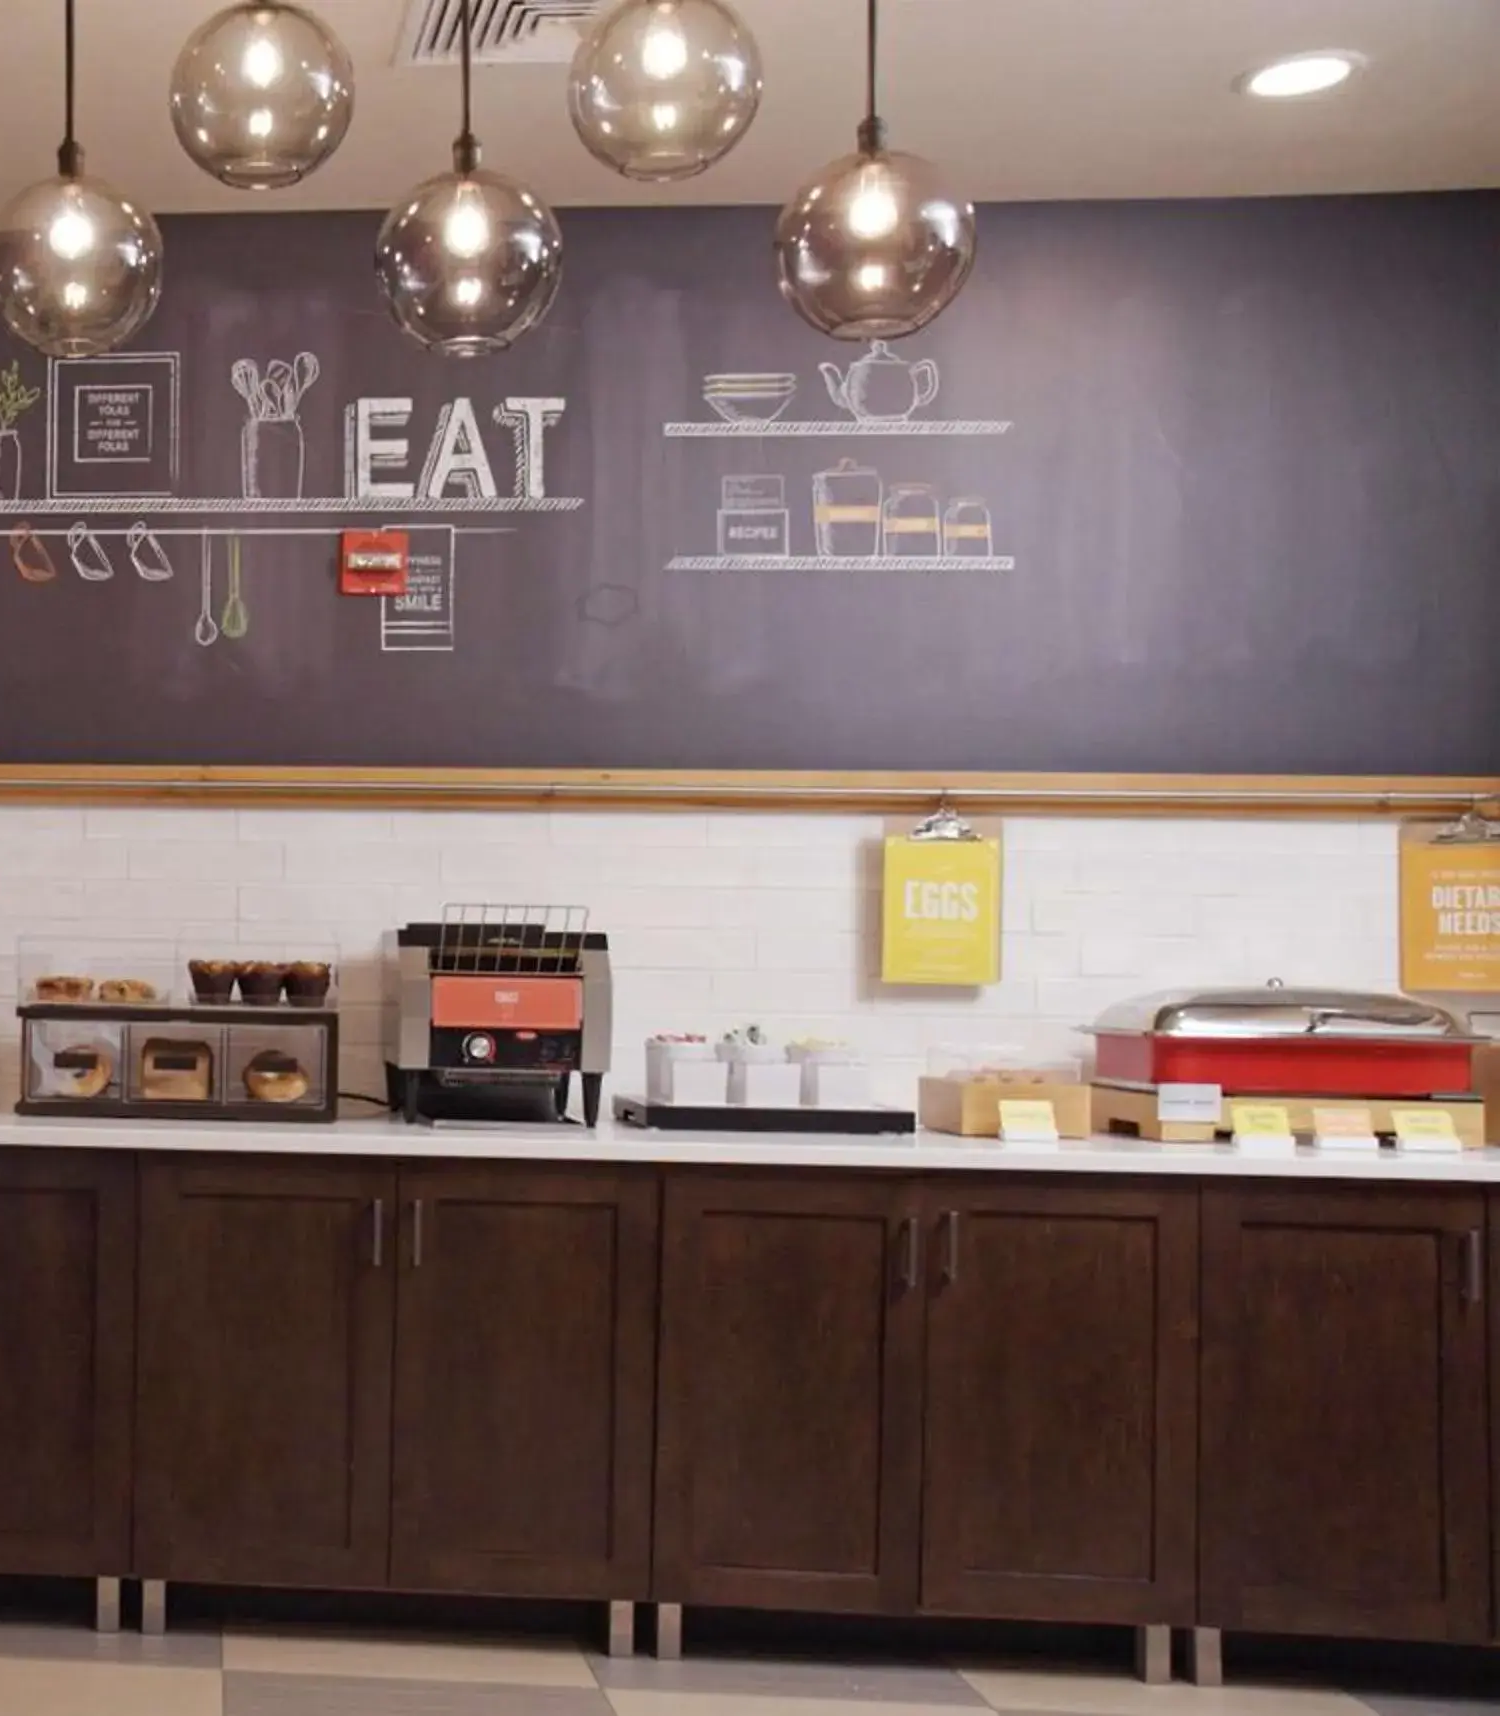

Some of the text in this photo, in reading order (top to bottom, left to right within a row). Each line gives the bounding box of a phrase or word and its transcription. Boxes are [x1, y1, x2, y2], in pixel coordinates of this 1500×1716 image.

[87, 429, 140, 440] DIFFERENT
[344, 397, 566, 500] EAT
[394, 594, 442, 612] SMILE
[904, 879, 979, 922] EGGS
[1439, 911, 1500, 935] NEEDS
